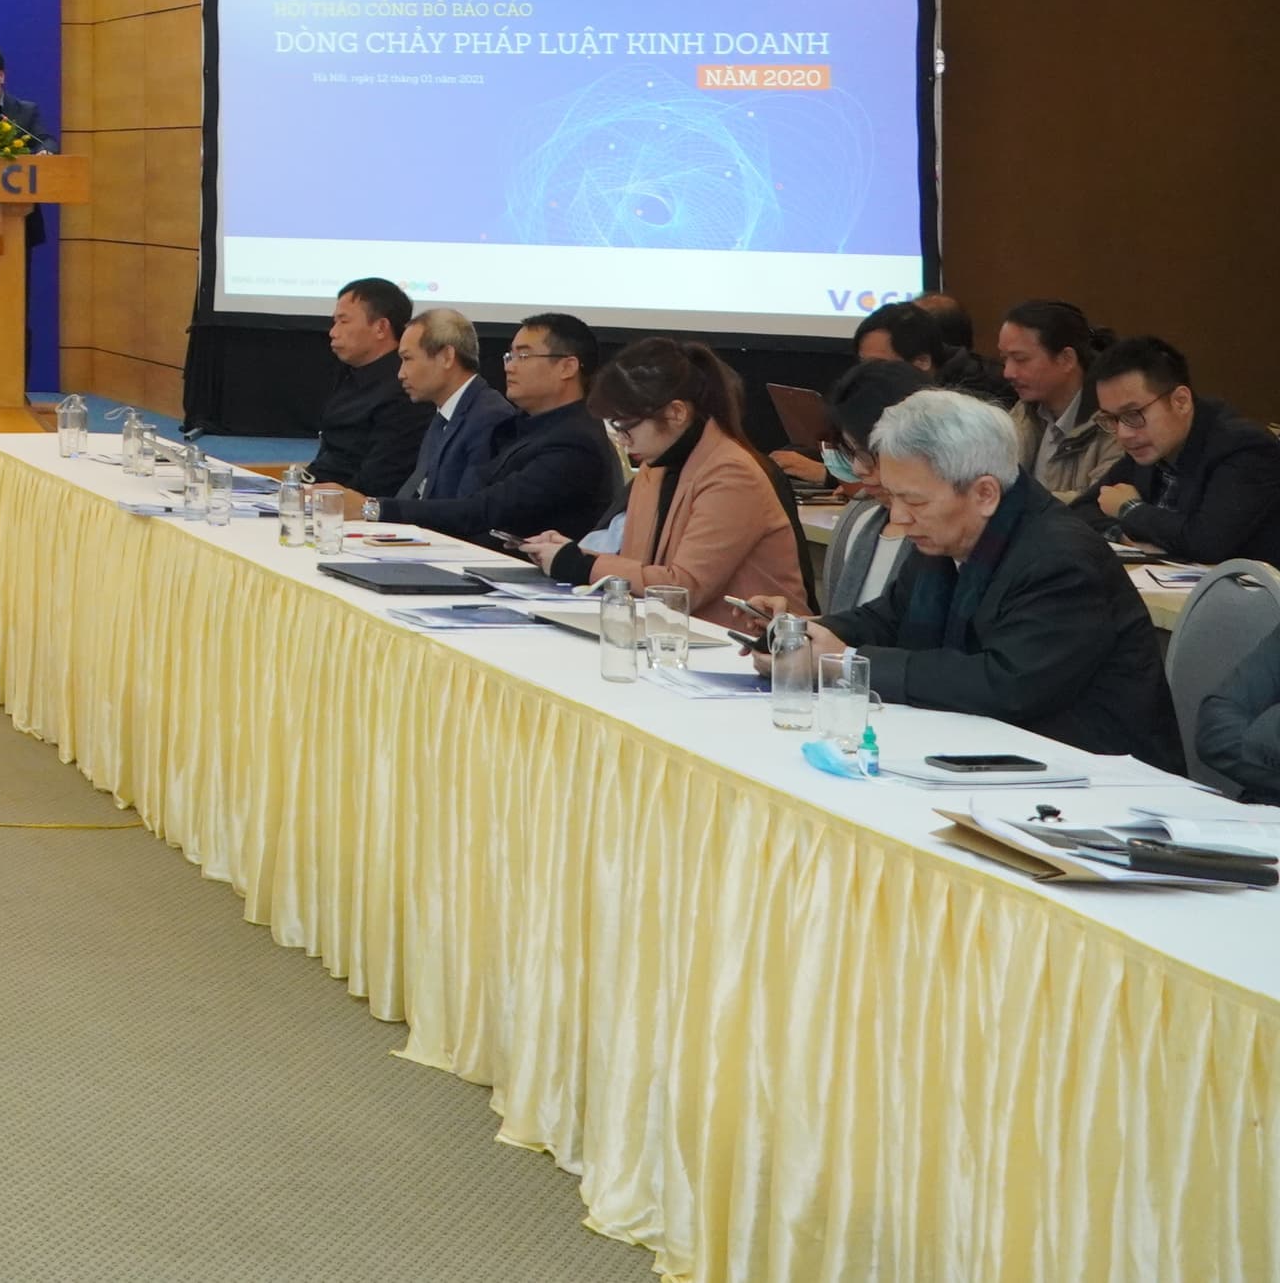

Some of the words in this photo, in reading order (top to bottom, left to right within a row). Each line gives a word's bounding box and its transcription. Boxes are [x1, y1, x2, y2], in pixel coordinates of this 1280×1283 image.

[453, 0, 489, 17] BÁO
[494, 0, 533, 17] CÁO
[275, 24, 358, 54] DÒNG
[365, 25, 446, 54] CHẢY
[454, 25, 532, 55] PHÁP
[539, 25, 619, 59] LUẬT
[626, 32, 705, 55] KINH
[713, 32, 830, 56] DOANH
[704, 65, 756, 87] NĂM
[763, 70, 821, 87] 2020
